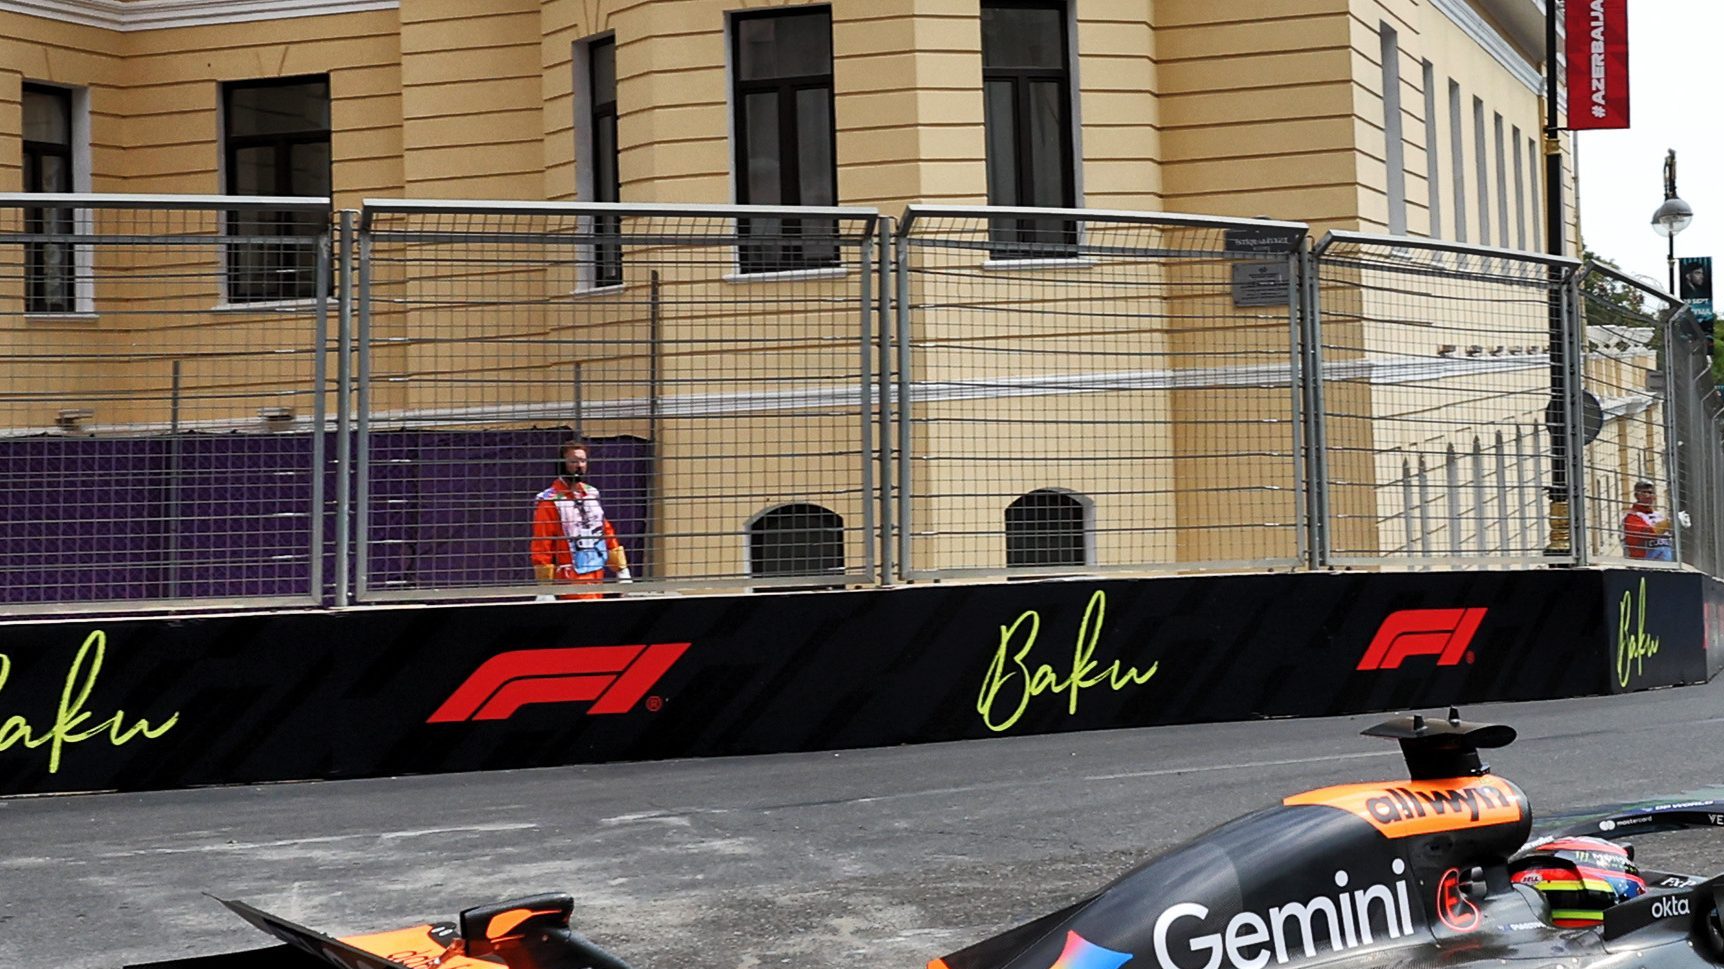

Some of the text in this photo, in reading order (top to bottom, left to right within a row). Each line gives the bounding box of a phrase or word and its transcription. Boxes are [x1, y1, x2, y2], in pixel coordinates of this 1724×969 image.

[1590, 0, 1606, 118] #AZERBAIJA
[1617, 576, 1660, 688] Baku
[976, 589, 1158, 732] Baku
[0, 629, 180, 774] aku
[1366, 785, 1510, 824] allwyn
[1616, 815, 1653, 826] mastercard
[1522, 876, 1540, 884] BELL
[1660, 877, 1697, 888] FxP
[1651, 896, 1690, 918] okta
